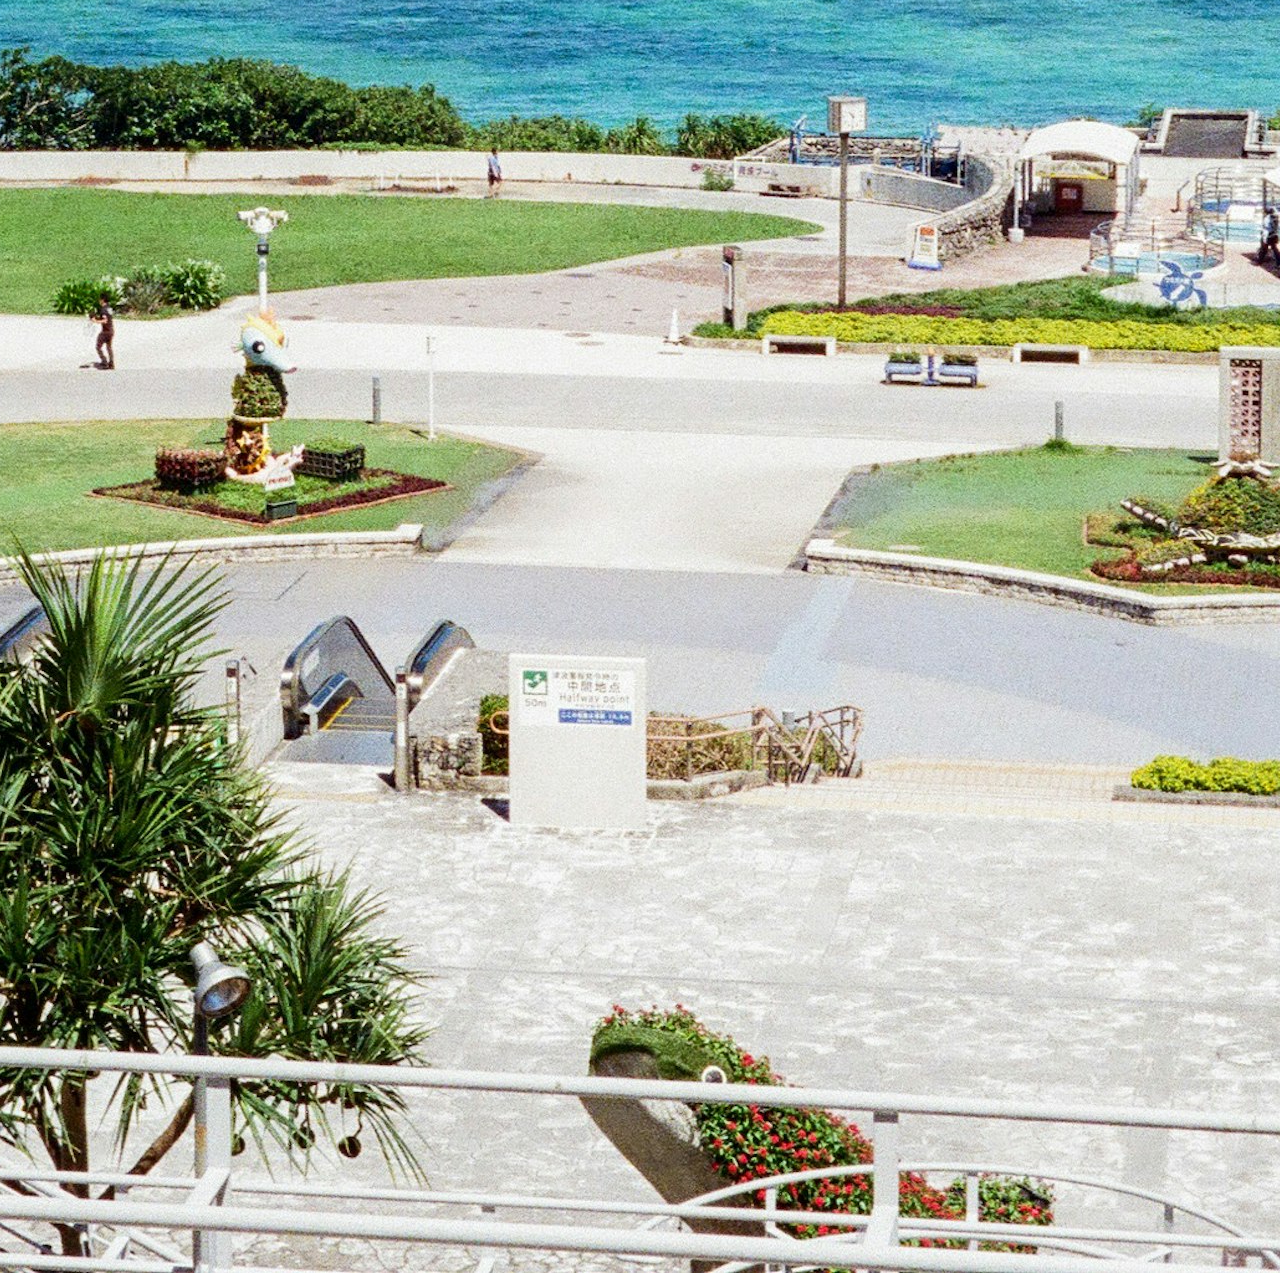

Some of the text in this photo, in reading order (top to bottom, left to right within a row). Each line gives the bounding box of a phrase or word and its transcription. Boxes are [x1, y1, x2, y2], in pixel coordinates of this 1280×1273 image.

[567, 681, 621, 693] 中間地点
[524, 698, 547, 708] 50m
[559, 692, 630, 705] Halfway point
